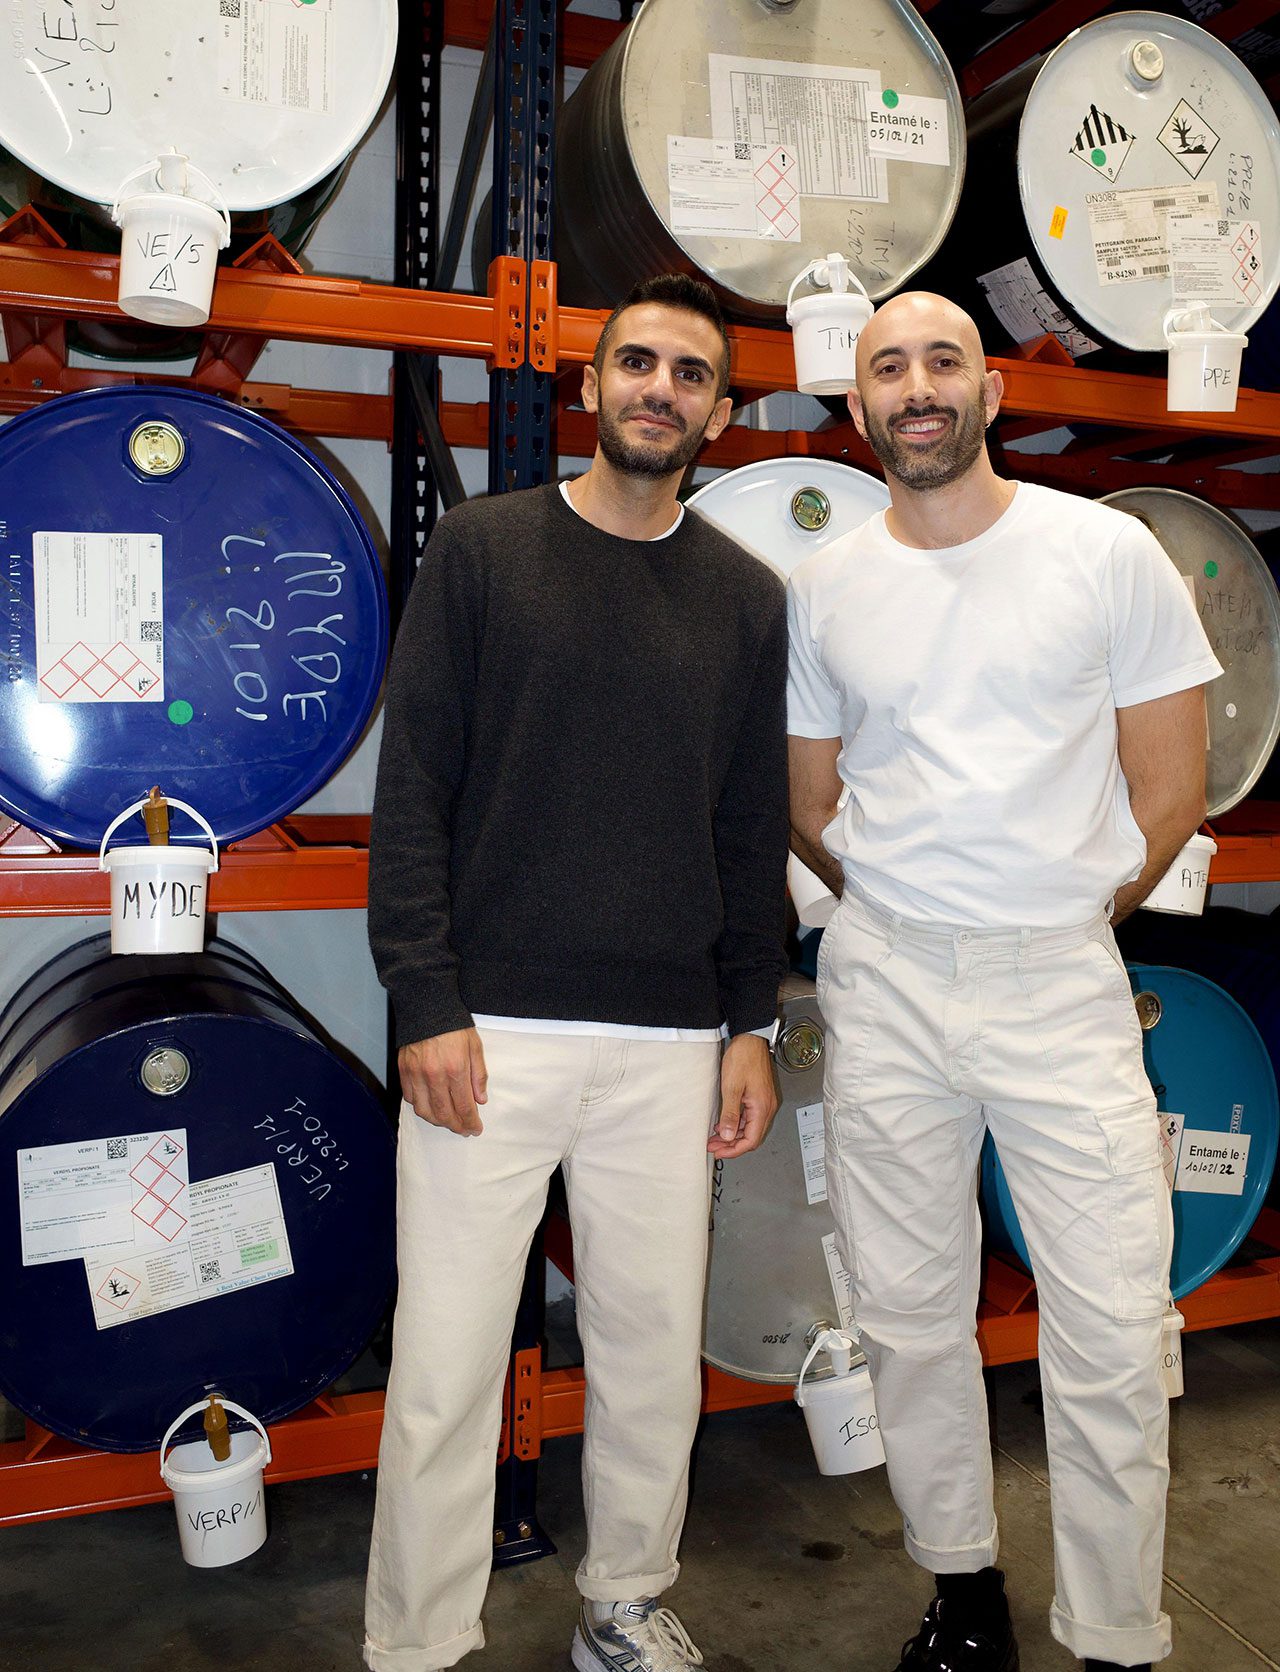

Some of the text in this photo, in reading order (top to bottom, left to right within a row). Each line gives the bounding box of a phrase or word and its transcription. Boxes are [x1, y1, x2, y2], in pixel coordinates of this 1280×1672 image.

[870, 111, 917, 127] Entamé
[920, 117, 930, 129] le
[1108, 168, 1114, 176] 9
[1085, 193, 1117, 204] UN3082
[137, 231, 204, 264] VE/5
[1107, 268, 1137, 280] B-84280
[1204, 368, 1232, 388] PPE
[274, 552, 346, 722] MYDE
[123, 881, 202, 920] MYDE
[253, 1114, 332, 1201] VERP/1
[1189, 1145, 1228, 1159] Entamé
[1230, 1148, 1240, 1160] le
[72, 1164, 100, 1173] PROPIONATE
[204, 1181, 239, 1195] PROPIONATE
[267, 1268, 289, 1280] Product
[1162, 1352, 1181, 1369] OX
